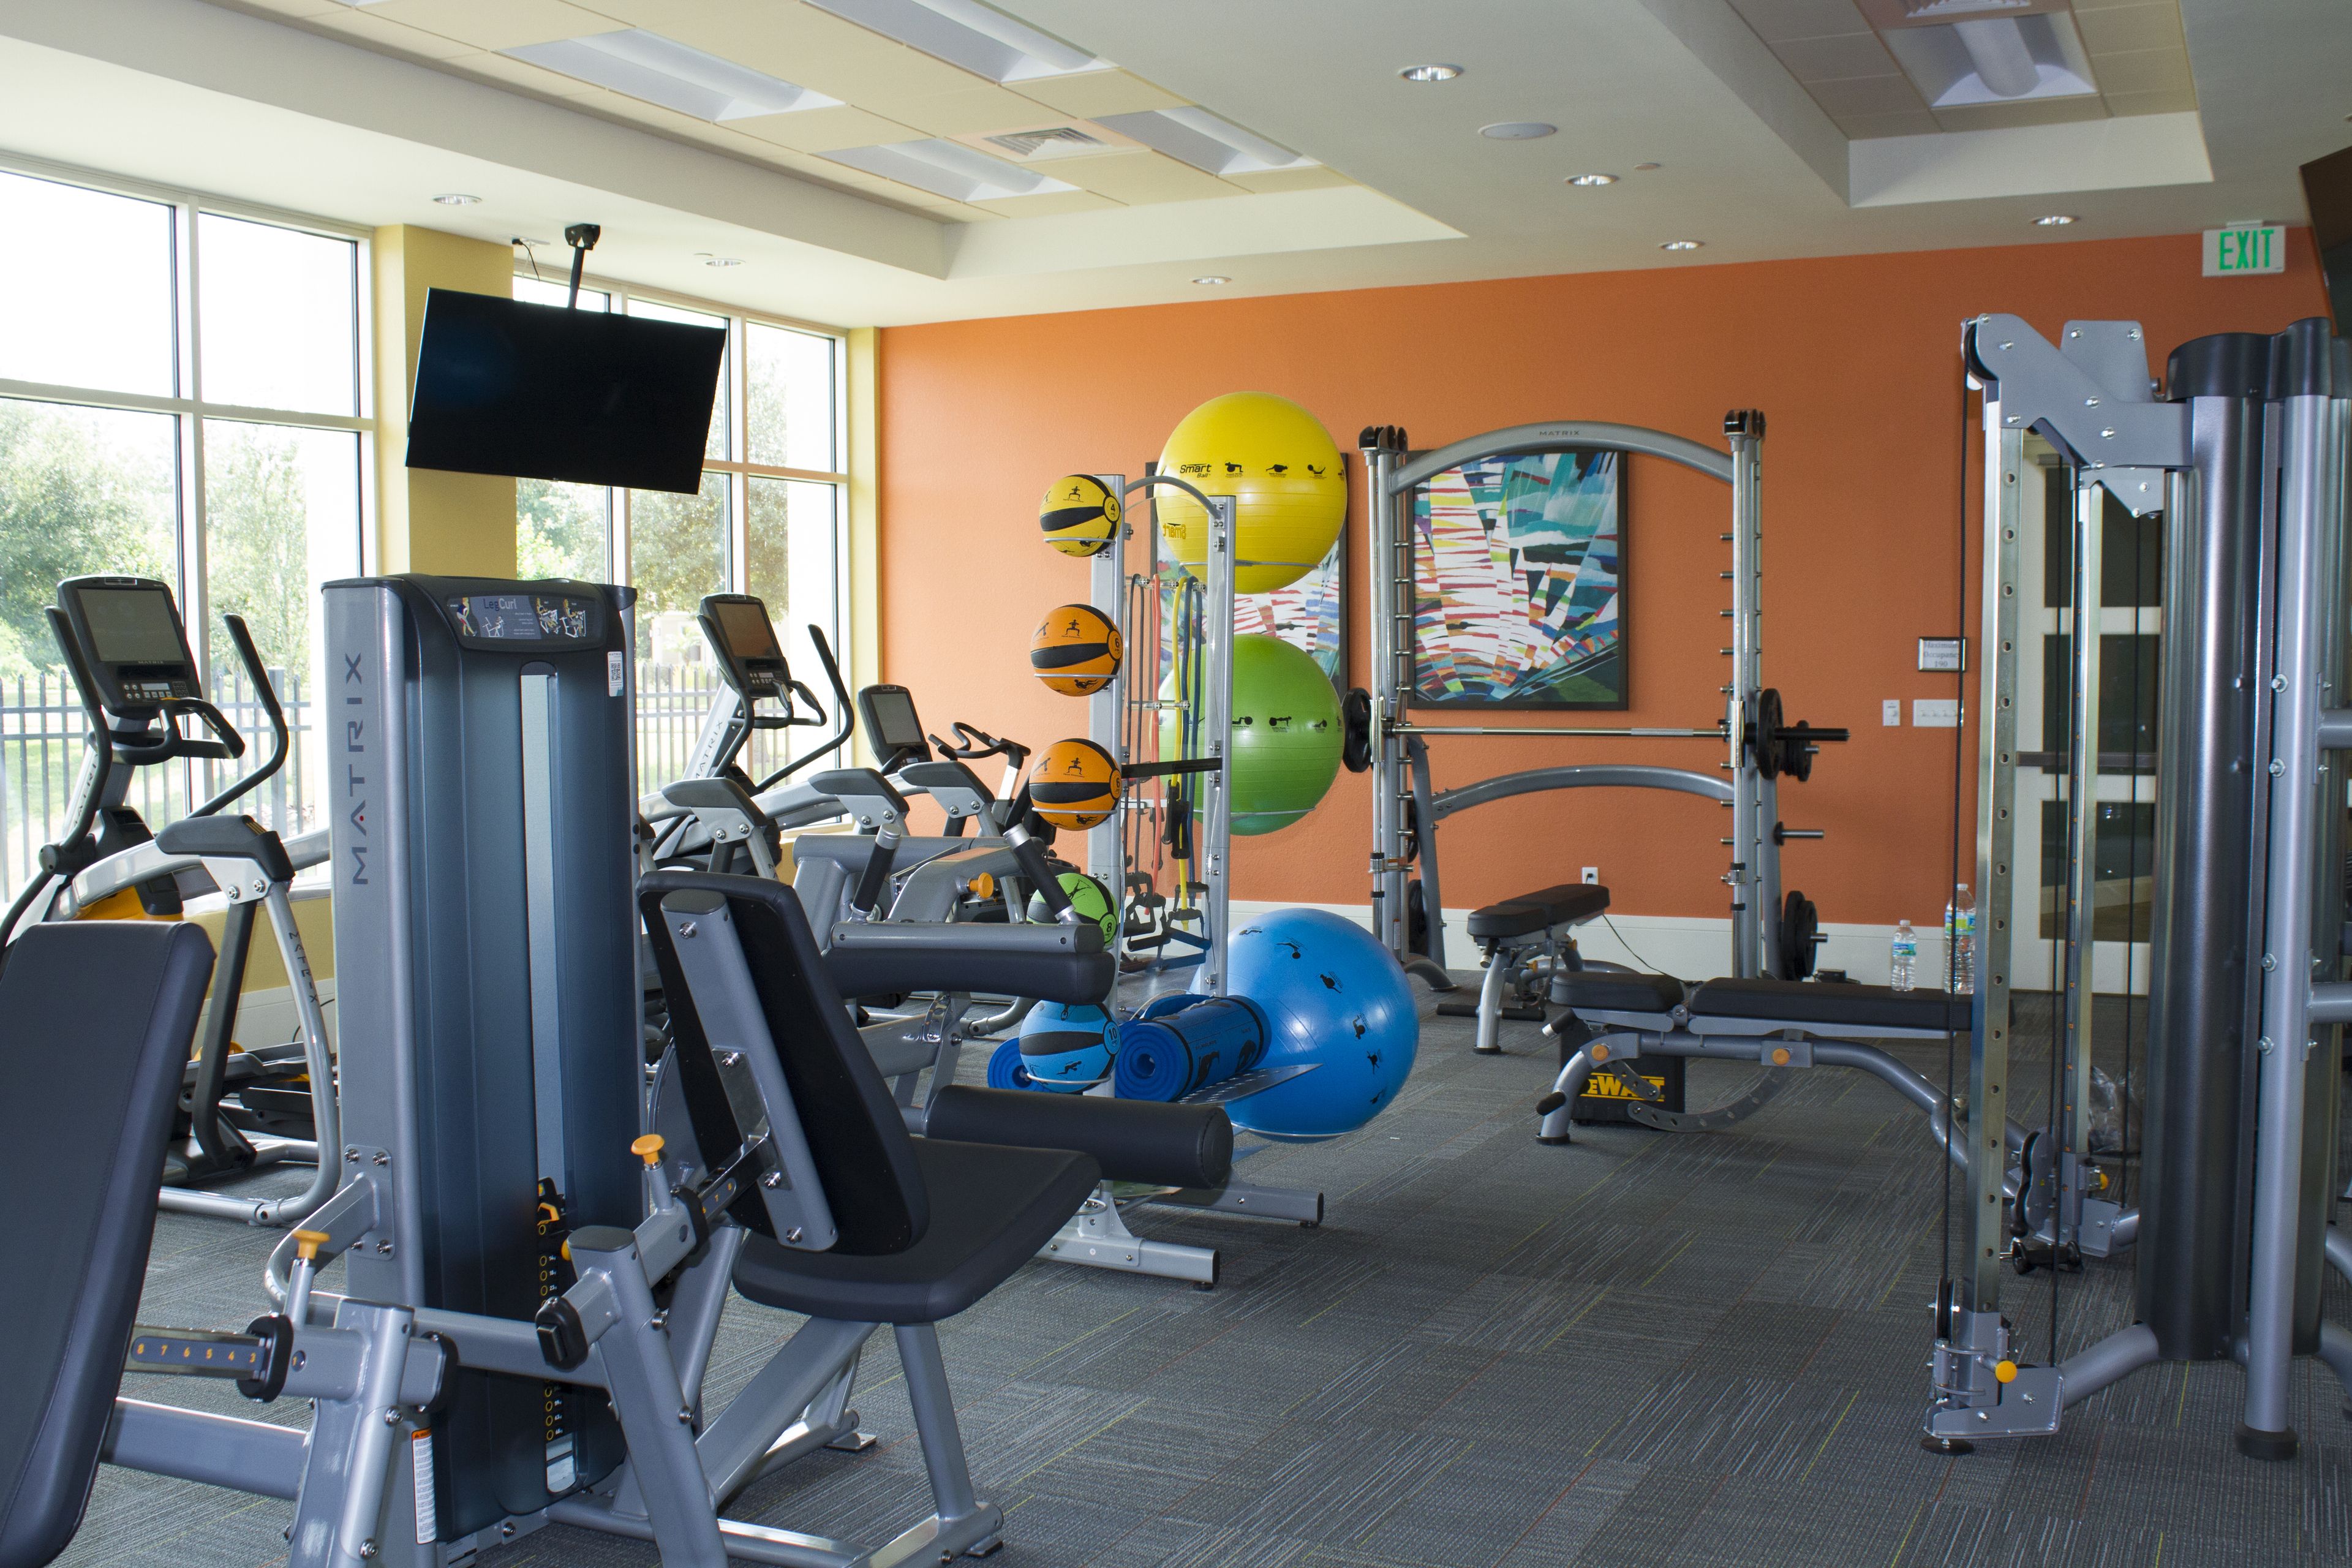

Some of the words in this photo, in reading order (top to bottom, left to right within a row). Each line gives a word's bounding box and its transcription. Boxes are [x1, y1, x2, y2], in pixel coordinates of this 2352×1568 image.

[2219, 229, 2274, 270] EXIT
[1180, 463, 1212, 473] Smart
[483, 598, 517, 611] LegCurl
[1115, 638, 1120, 648] 6
[345, 652, 368, 884] MATRIX
[1106, 922, 1112, 932] 8
[288, 931, 318, 1003] MATRIX
[1109, 1027, 1117, 1040] 10
[137, 1343, 145, 1354] 8
[161, 1344, 168, 1355] 7
[183, 1347, 190, 1357] 6
[205, 1348, 213, 1359] 5
[228, 1351, 235, 1361] 4
[249, 1352, 256, 1363] 3
[292, 1356, 298, 1366] 1
